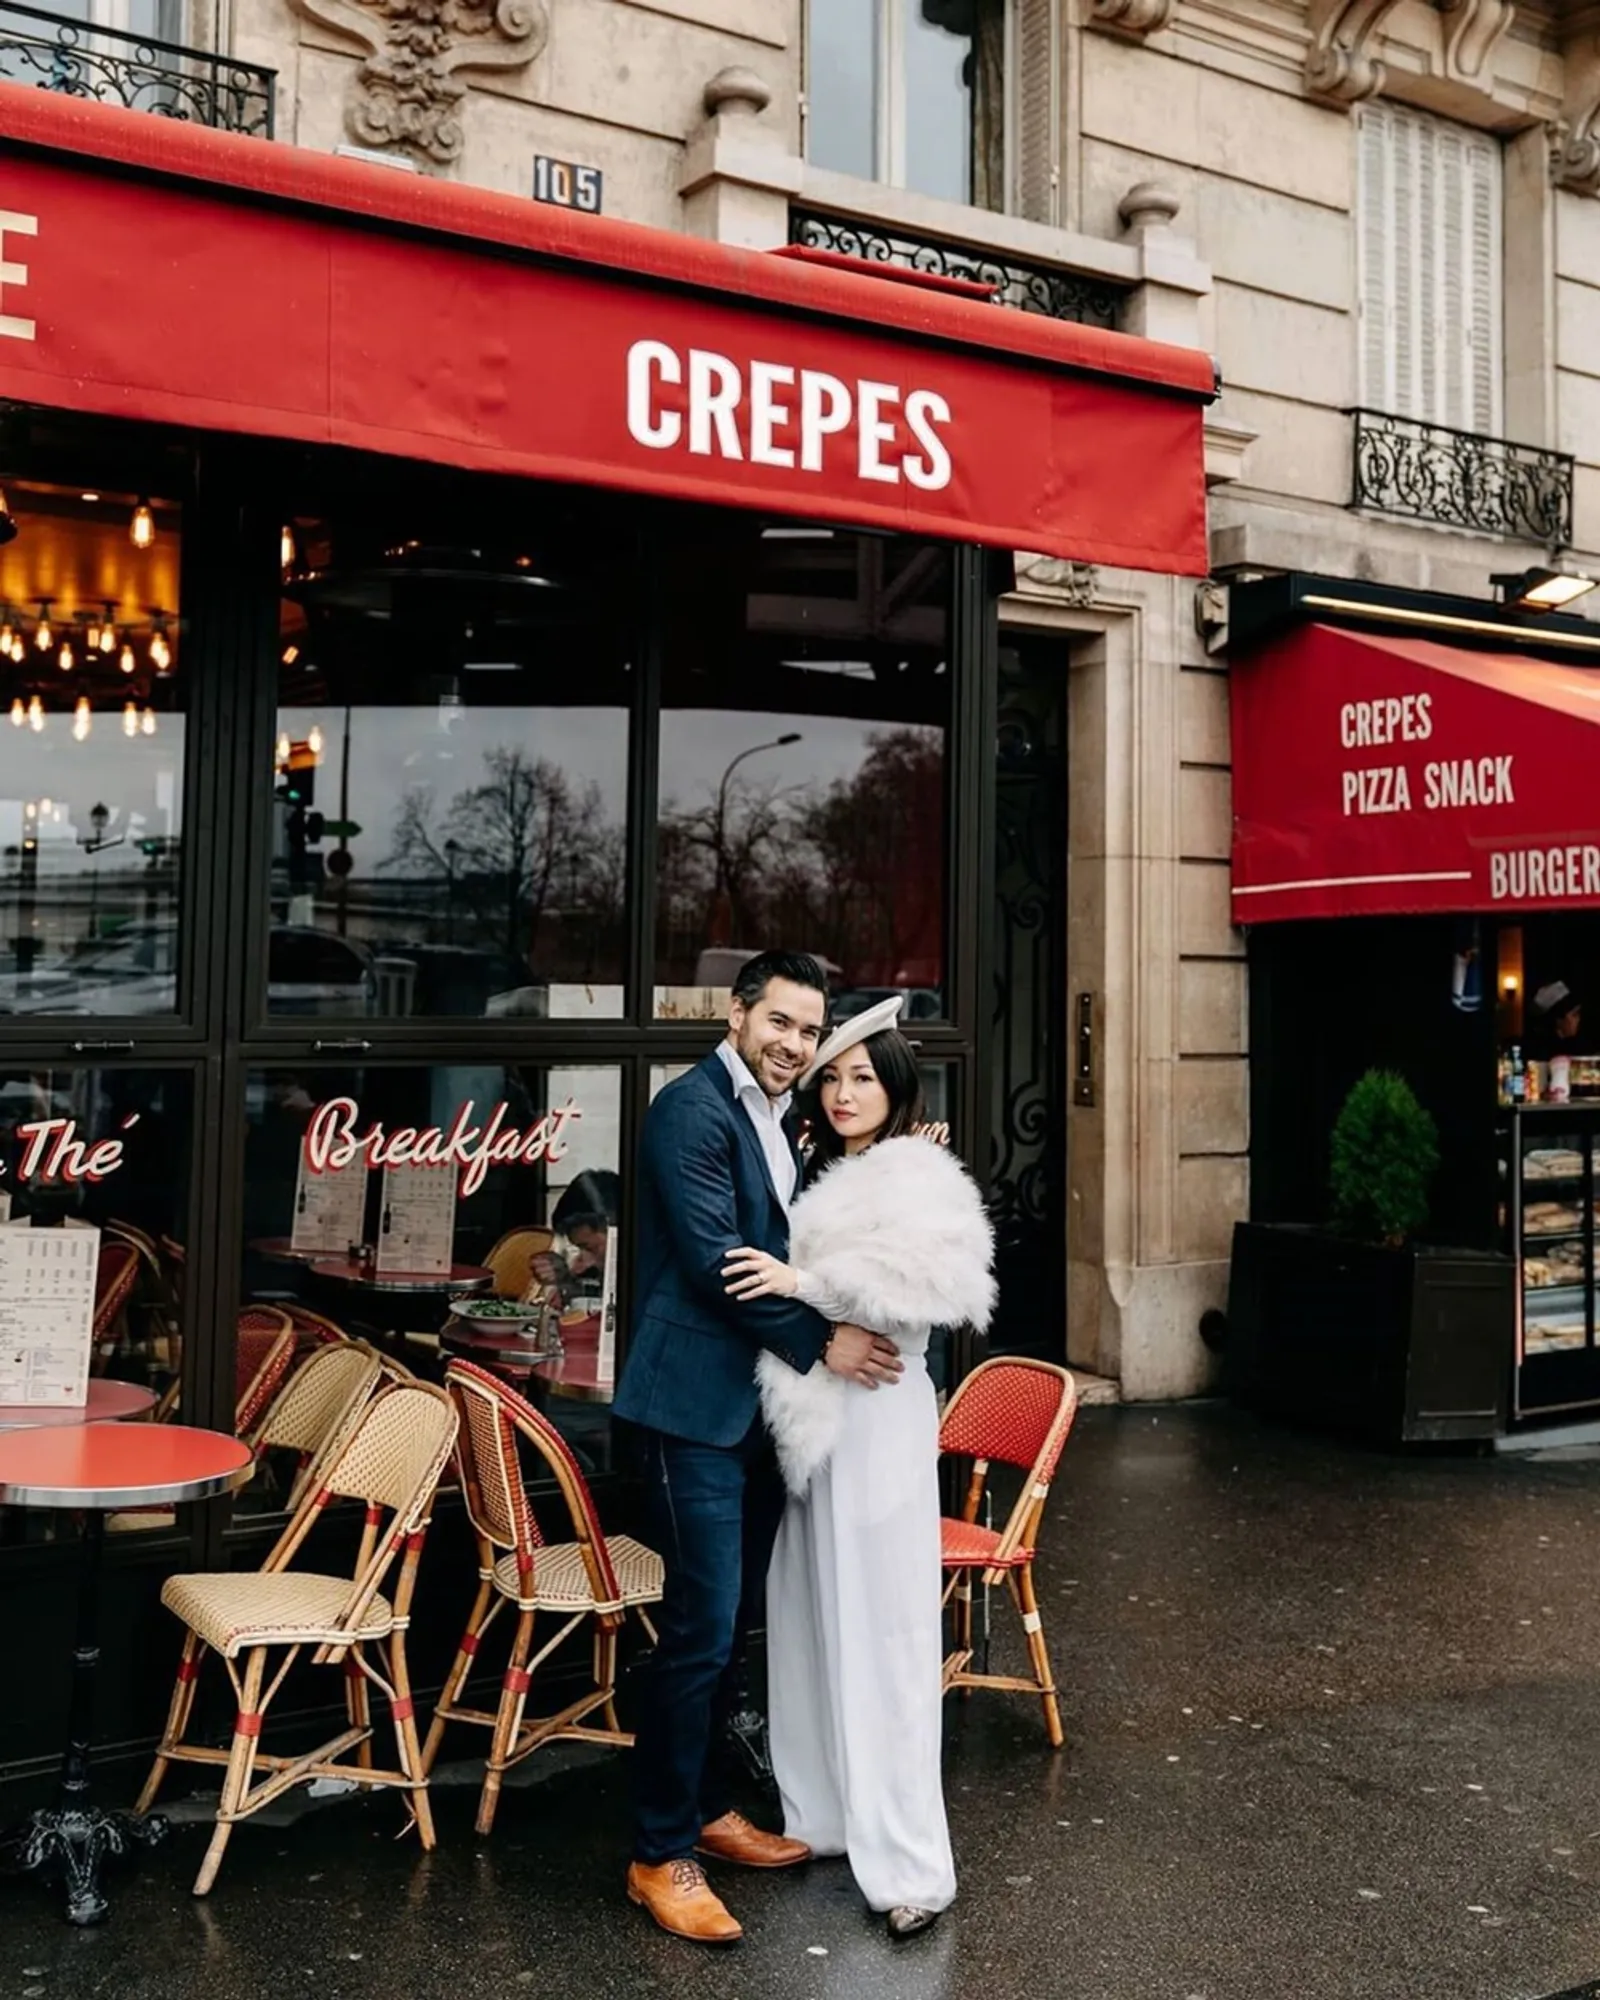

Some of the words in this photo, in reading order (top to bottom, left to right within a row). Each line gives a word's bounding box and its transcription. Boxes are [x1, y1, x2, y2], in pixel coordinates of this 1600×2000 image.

[537, 159, 597, 210] 105
[627, 339, 952, 491] CREPES
[1341, 693, 1432, 748] CREPES
[1343, 765, 1412, 816] PIZZA
[1424, 755, 1514, 809] SNACK
[1490, 845, 1600, 899] BURGER
[17, 1113, 140, 1182] Thé
[306, 1097, 583, 1197] Breakfast
